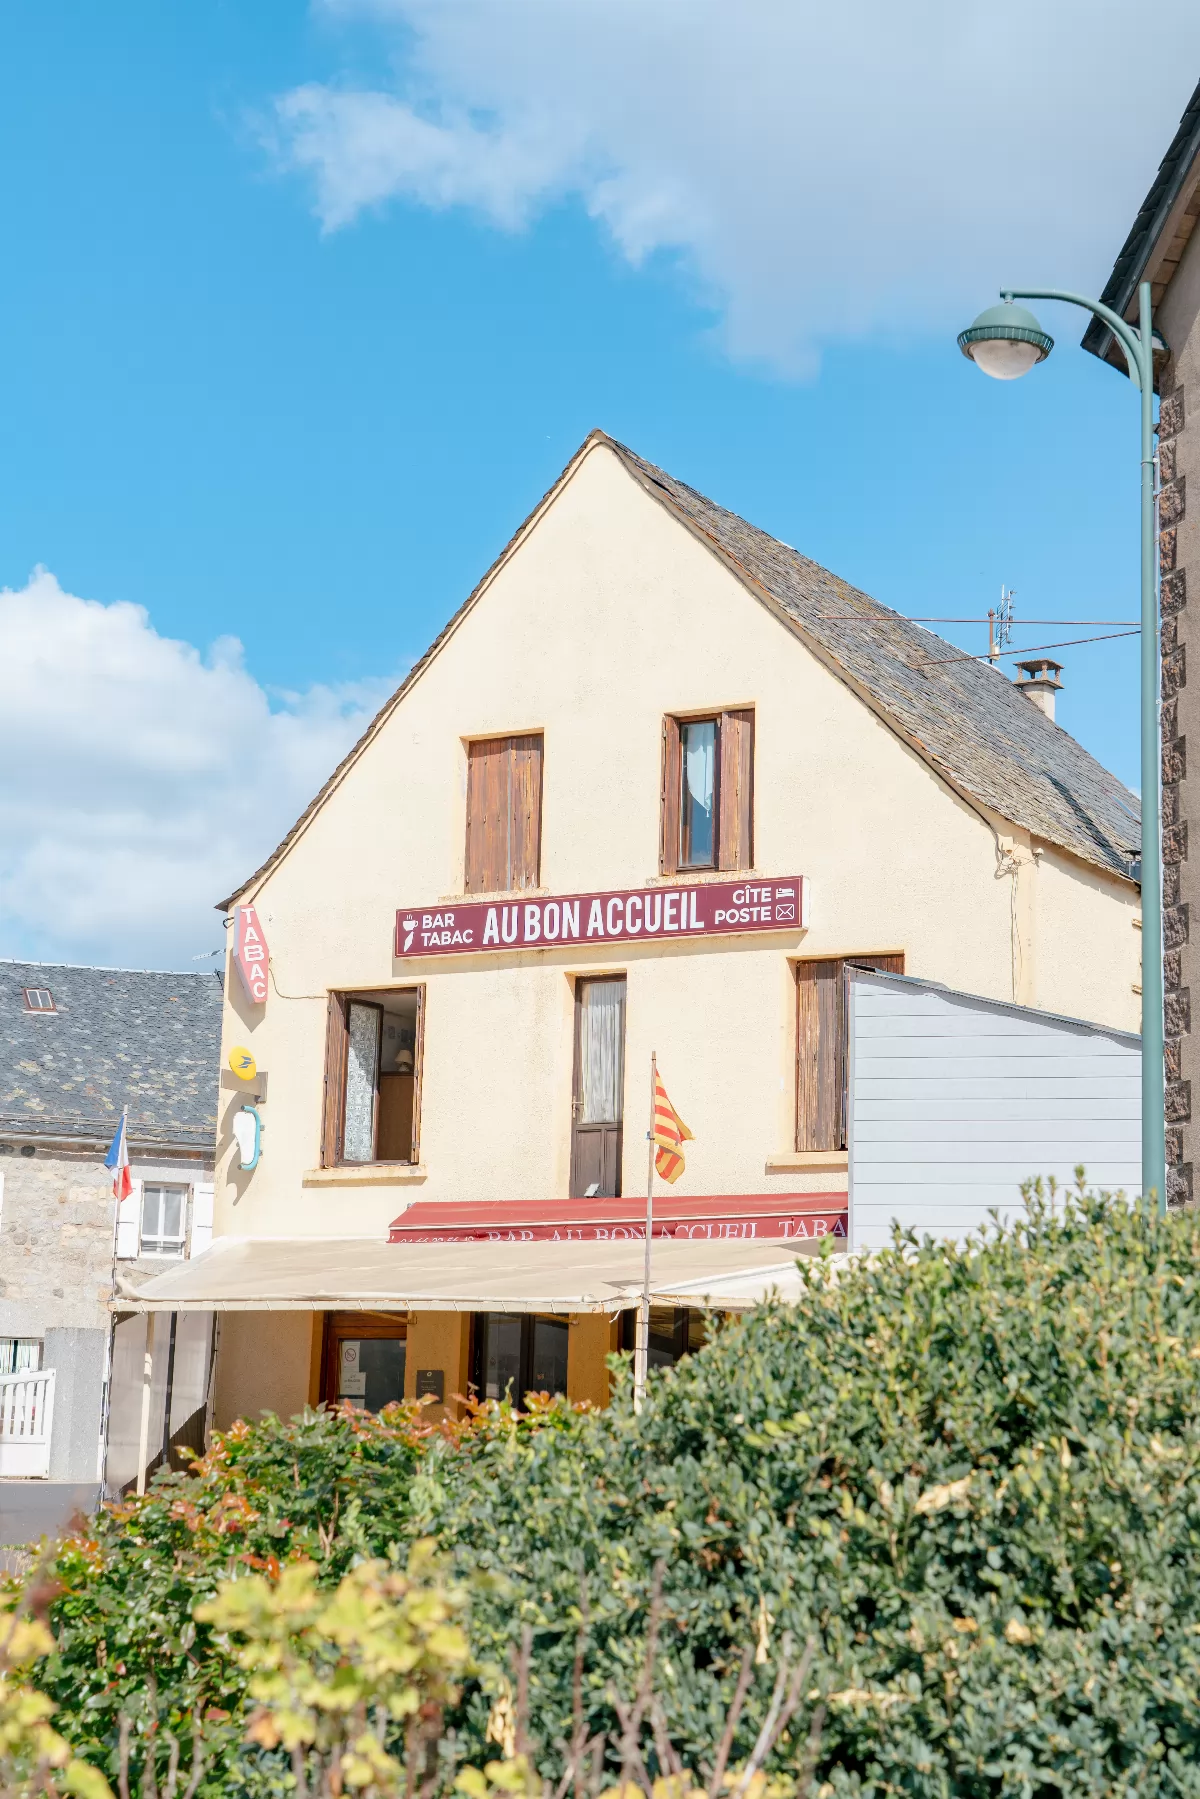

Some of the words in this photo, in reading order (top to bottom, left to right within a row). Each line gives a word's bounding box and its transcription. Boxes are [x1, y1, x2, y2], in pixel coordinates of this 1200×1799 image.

[732, 885, 772, 905] GÎTE
[422, 913, 455, 929] BAR
[482, 906, 519, 944] AU
[523, 901, 580, 942] BON
[586, 891, 705, 937] ACCUEIL
[714, 906, 772, 925] POSTE
[421, 929, 474, 947] TABAC
[241, 908, 267, 998] TABAC
[778, 1218, 847, 1238] TABA
